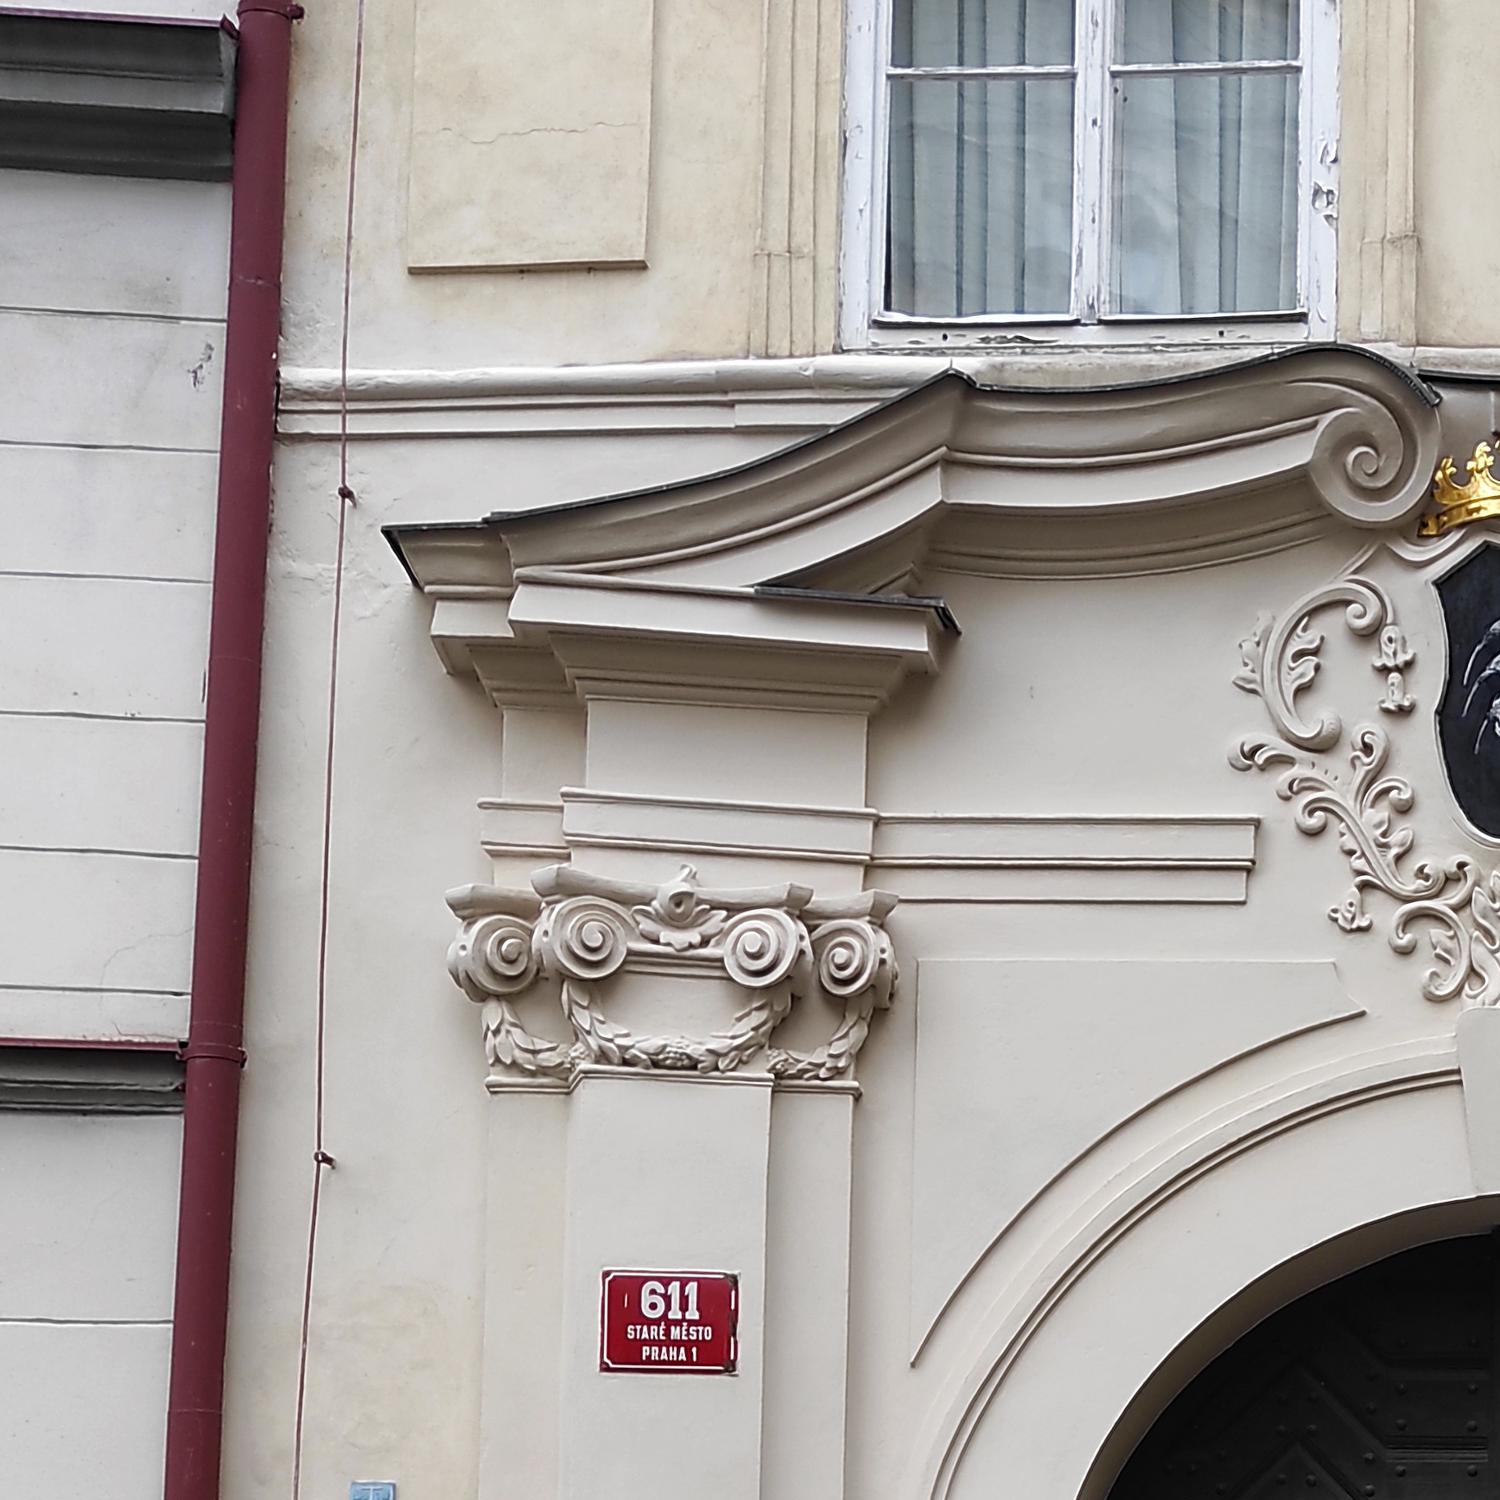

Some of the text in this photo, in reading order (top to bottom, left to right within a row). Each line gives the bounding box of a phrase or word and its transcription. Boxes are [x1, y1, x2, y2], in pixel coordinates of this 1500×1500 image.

[640, 1280, 700, 1320] 611
[627, 1321, 712, 1341] STARÉ MĚSTO
[642, 1346, 698, 1362] PRAHA 1
